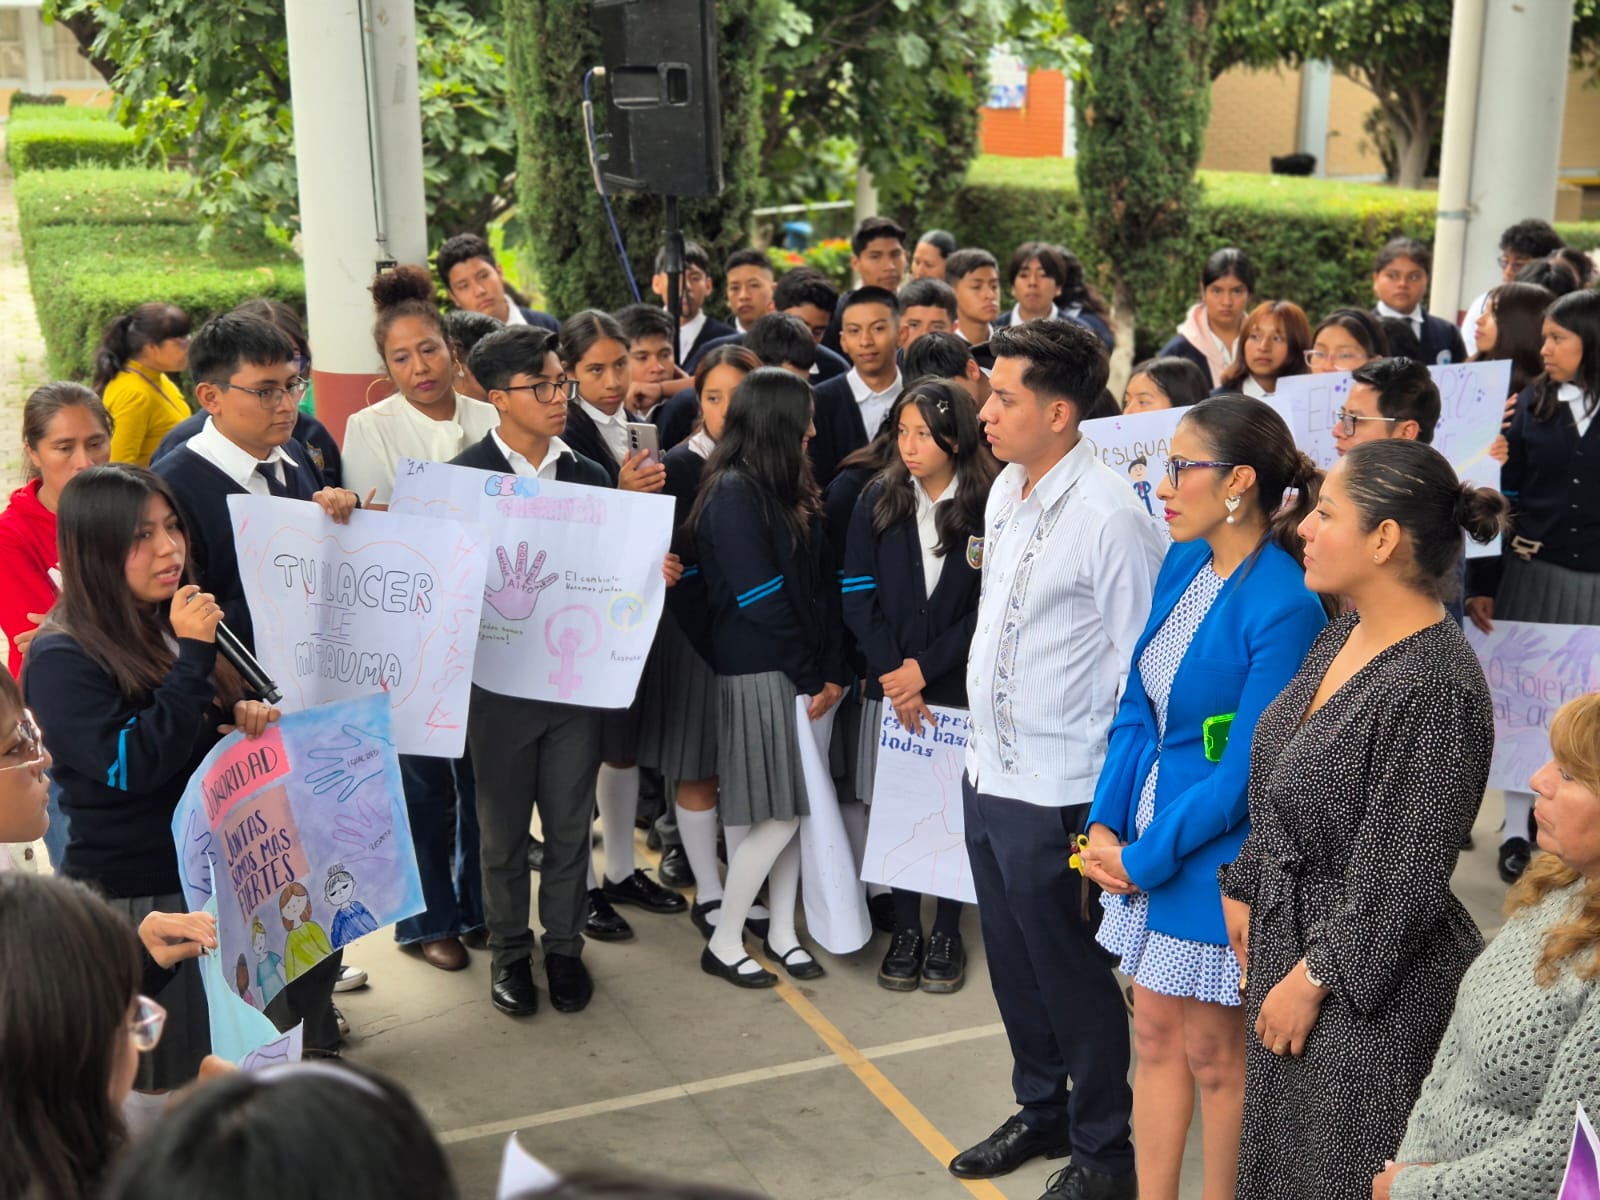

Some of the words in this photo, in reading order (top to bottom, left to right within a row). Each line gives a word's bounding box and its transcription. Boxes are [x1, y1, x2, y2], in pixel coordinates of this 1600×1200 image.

[273, 553, 317, 595] TU
[224, 809, 268, 867] JUNTAS
[231, 850, 258, 892] SOMOS
[259, 826, 292, 863] MÁS
[237, 853, 295, 922] FUERTES
